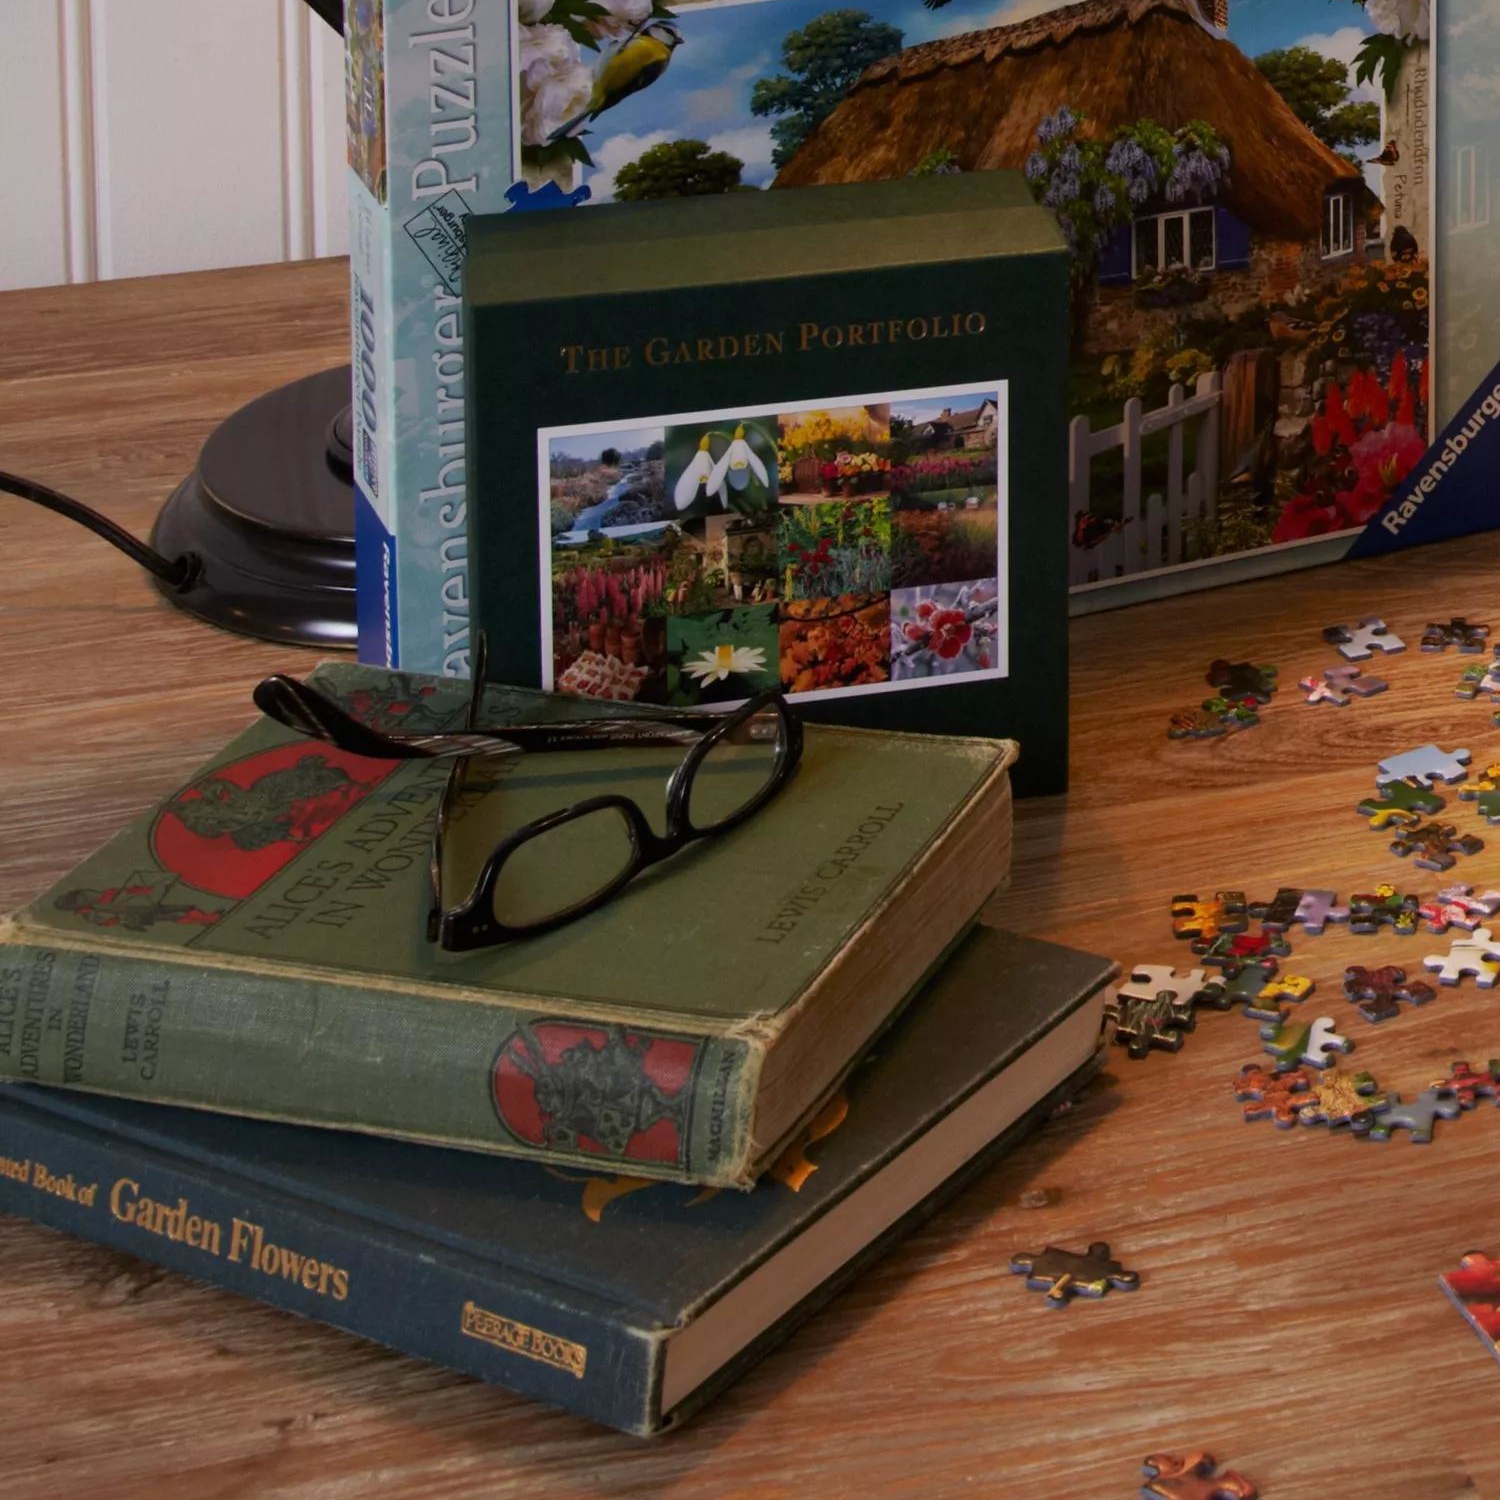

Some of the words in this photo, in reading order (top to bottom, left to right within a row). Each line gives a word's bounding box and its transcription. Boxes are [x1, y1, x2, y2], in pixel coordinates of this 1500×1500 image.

[1413, 68, 1428, 186] Rhododendron
[419, 286, 470, 680] avensburger
[245, 859, 355, 940] ALICE'S
[306, 898, 364, 930] IN
[755, 885, 827, 945] LEWIS
[816, 801, 905, 881] CARROLL
[20, 951, 58, 1080] ADVENTURES
[47, 1006, 64, 1033] IN
[63, 953, 101, 1084] WONDERLAND
[122, 992, 146, 1065] LEWIS
[140, 980, 171, 1082] CARROLL
[705, 1049, 738, 1165] MACMILLAN
[32, 1162, 77, 1201] Book
[78, 1183, 98, 1208] of
[109, 1176, 221, 1262] Garden
[227, 1216, 350, 1301] Flowers
